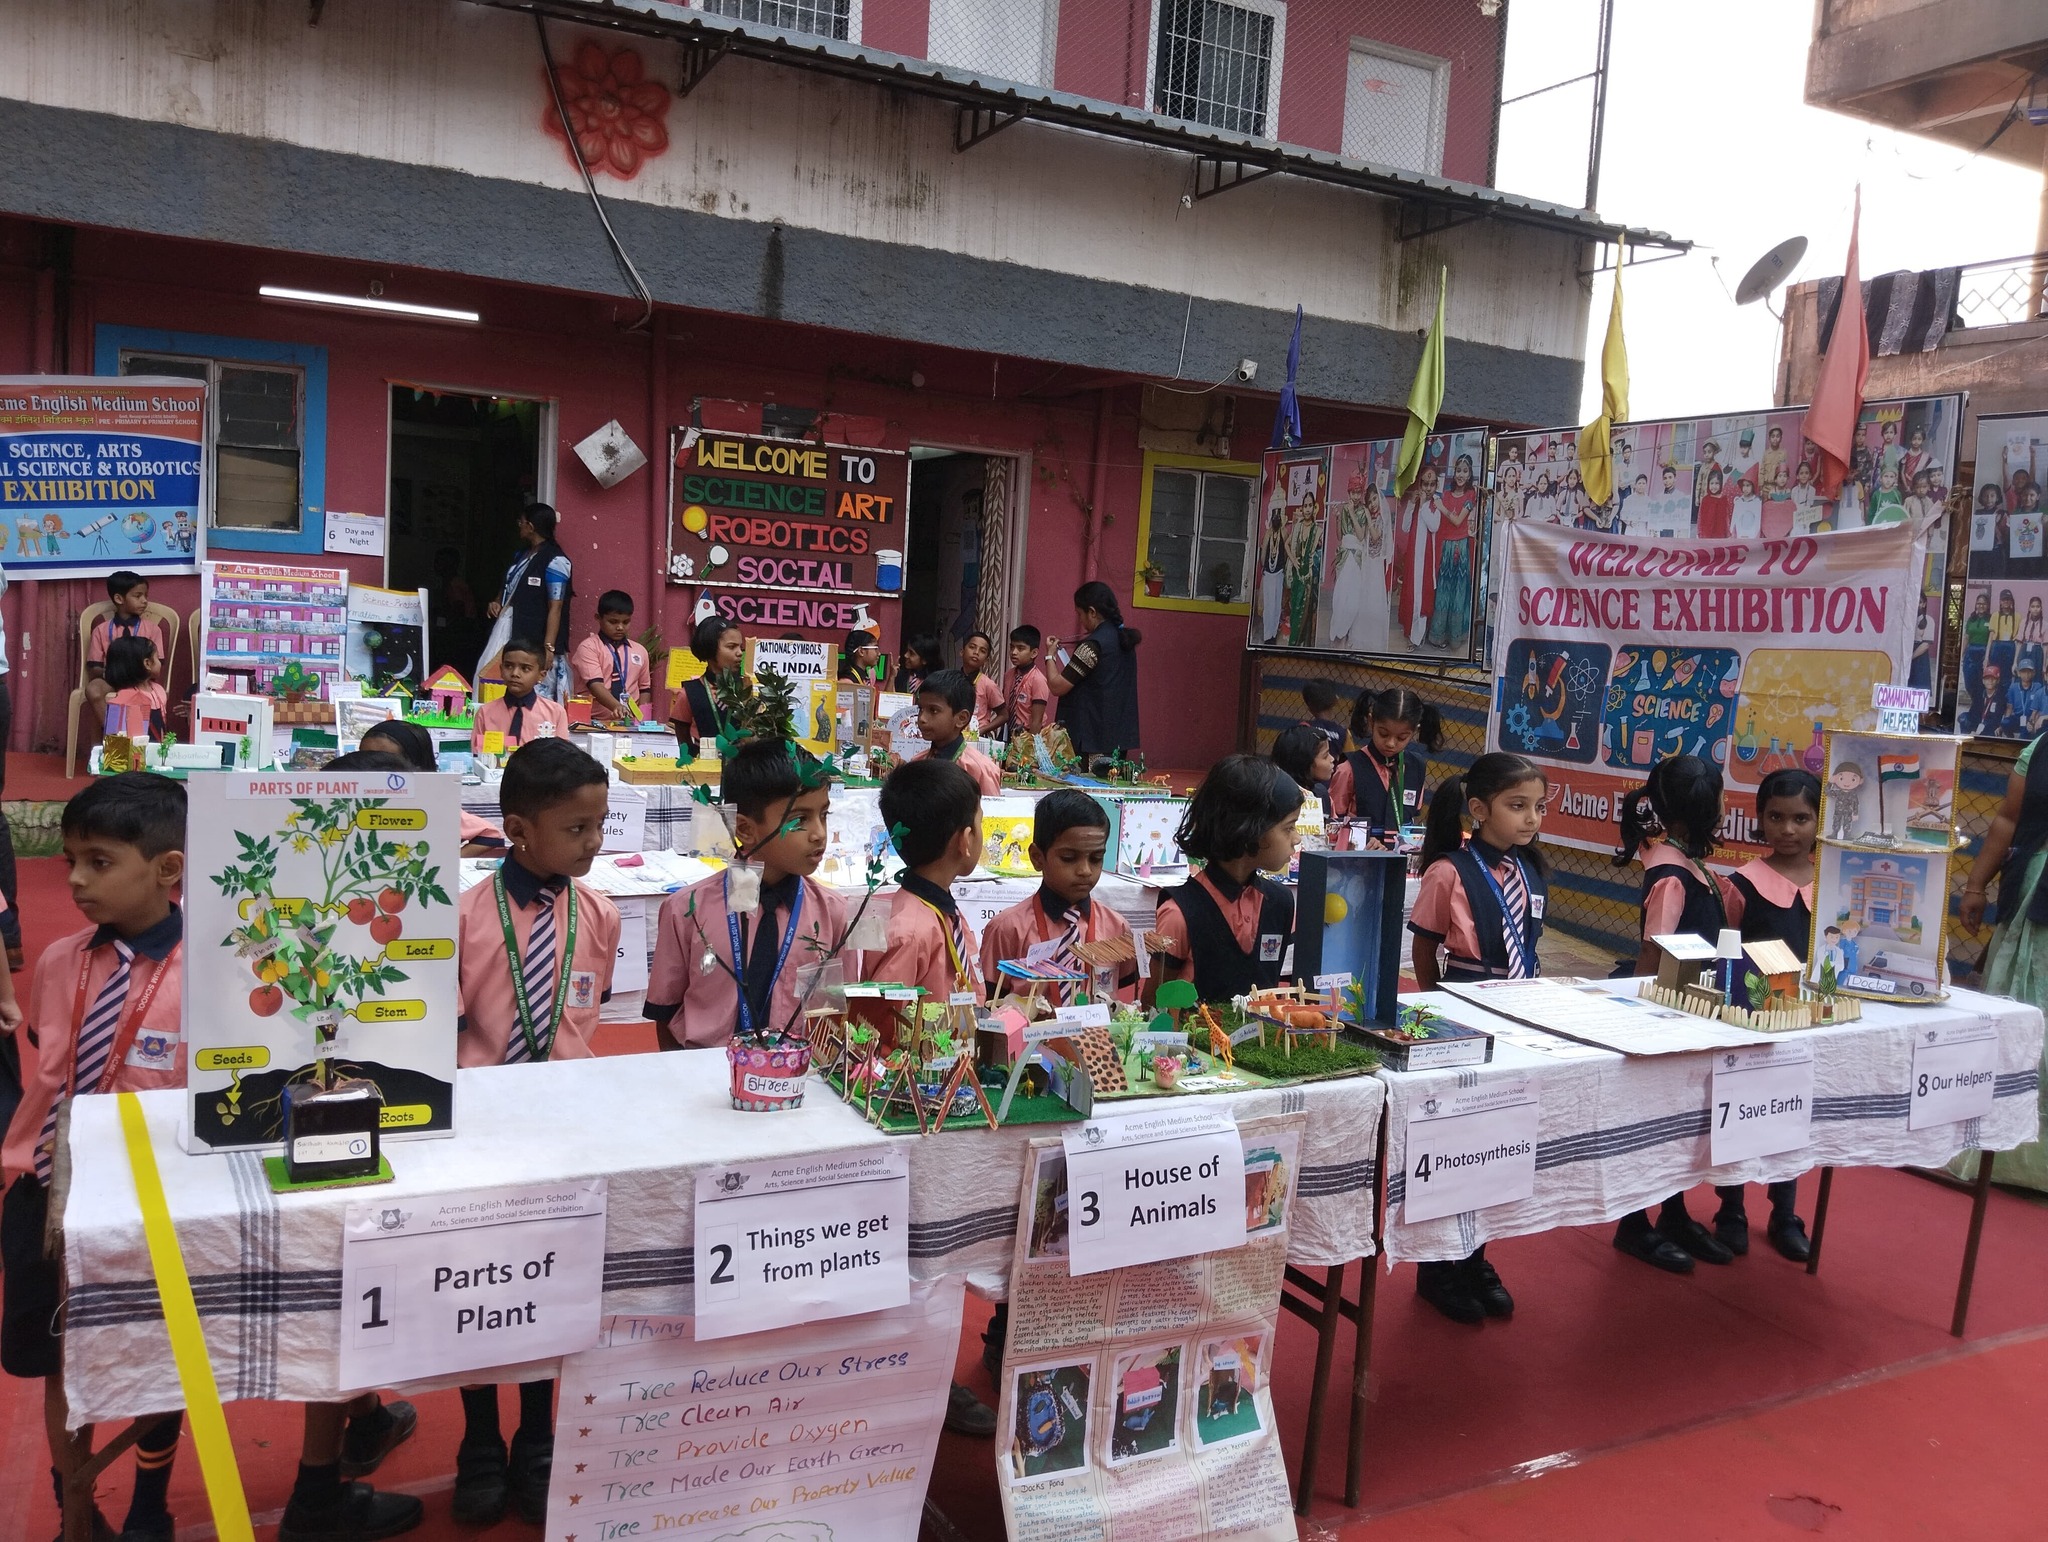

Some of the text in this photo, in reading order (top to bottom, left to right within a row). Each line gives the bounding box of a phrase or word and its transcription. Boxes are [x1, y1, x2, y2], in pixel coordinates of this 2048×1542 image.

[0, 395, 200, 415] cme English Medium School
[10, 443, 142, 460] SCIENCE, ARTS
[697, 439, 876, 484] WELCOME TO
[18, 461, 93, 476] SCIENCE
[97, 462, 112, 476] &
[116, 461, 201, 476] ROBOTICS
[3, 479, 156, 502] EXHIBITION
[684, 476, 893, 523] SCIENCE ART
[328, 530, 336, 540] 6
[345, 527, 358, 536] Day
[350, 538, 369, 546] Night
[709, 514, 869, 554] ROBOTICS
[1567, 537, 1819, 579] WELCOME TO
[311, 570, 335, 578] School
[737, 556, 852, 589] SOCIAL
[716, 595, 854, 629] SCIENCE
[1518, 586, 1889, 634] SCIENCE EXHIBITION
[760, 641, 822, 656] NATIONAL SYMBOLS
[782, 661, 822, 674] INDIA
[1632, 694, 1700, 722] SCIENCE
[1876, 686, 1929, 709] COMMUNITY
[1883, 712, 1919, 733] HELPERS
[250, 781, 359, 795] PARTS OF PLANT
[1560, 783, 1608, 820] Acme
[369, 814, 414, 826] Flower
[602, 826, 624, 836] ules
[981, 910, 995, 919] 3D
[406, 944, 435, 956] Leaf
[1852, 975, 1893, 992] Doctor
[136, 983, 155, 1012] SCHOOL
[374, 1006, 408, 1018] Stem
[213, 1053, 253, 1066] Seeds
[1917, 1069, 1993, 1097] 8 Our Helpers
[380, 1111, 415, 1123] Roots
[1124, 1112, 1214, 1132] Acme English Medium School
[1718, 1094, 1803, 1129] 7 Save Earth
[771, 1156, 885, 1179] Acme English Medium School
[1125, 1155, 1220, 1191] House of
[1414, 1139, 1531, 1183] 4 Photosynthesis
[780, 1178, 804, 1188] Science
[805, 1176, 817, 1185] and
[818, 1173, 836, 1182] Social
[836, 1170, 859, 1181] Science
[860, 1167, 891, 1178] Exhibition
[431, 1204, 584, 1228] Arts, Science and Social Science Exhibition
[438, 1192, 577, 1216] Acme English Medium School
[1079, 1190, 1217, 1228] 3 Animals
[746, 1214, 889, 1251] Things we get
[434, 1251, 556, 1293] Parts of
[709, 1243, 881, 1285] 2 from plants
[361, 1286, 537, 1334] 1 Plant
[619, 1350, 911, 1402] Tree Reduce Our Stress
[615, 1397, 805, 1435] Tree Clean Air
[608, 1416, 869, 1470] Tree Provide Oxygen
[602, 1440, 905, 1502] Tree Made Our Earth Green
[595, 1519, 641, 1541] Tree
[652, 1502, 741, 1532] Increase
[750, 1496, 780, 1512] Our
[867, 1464, 917, 1489] Value
